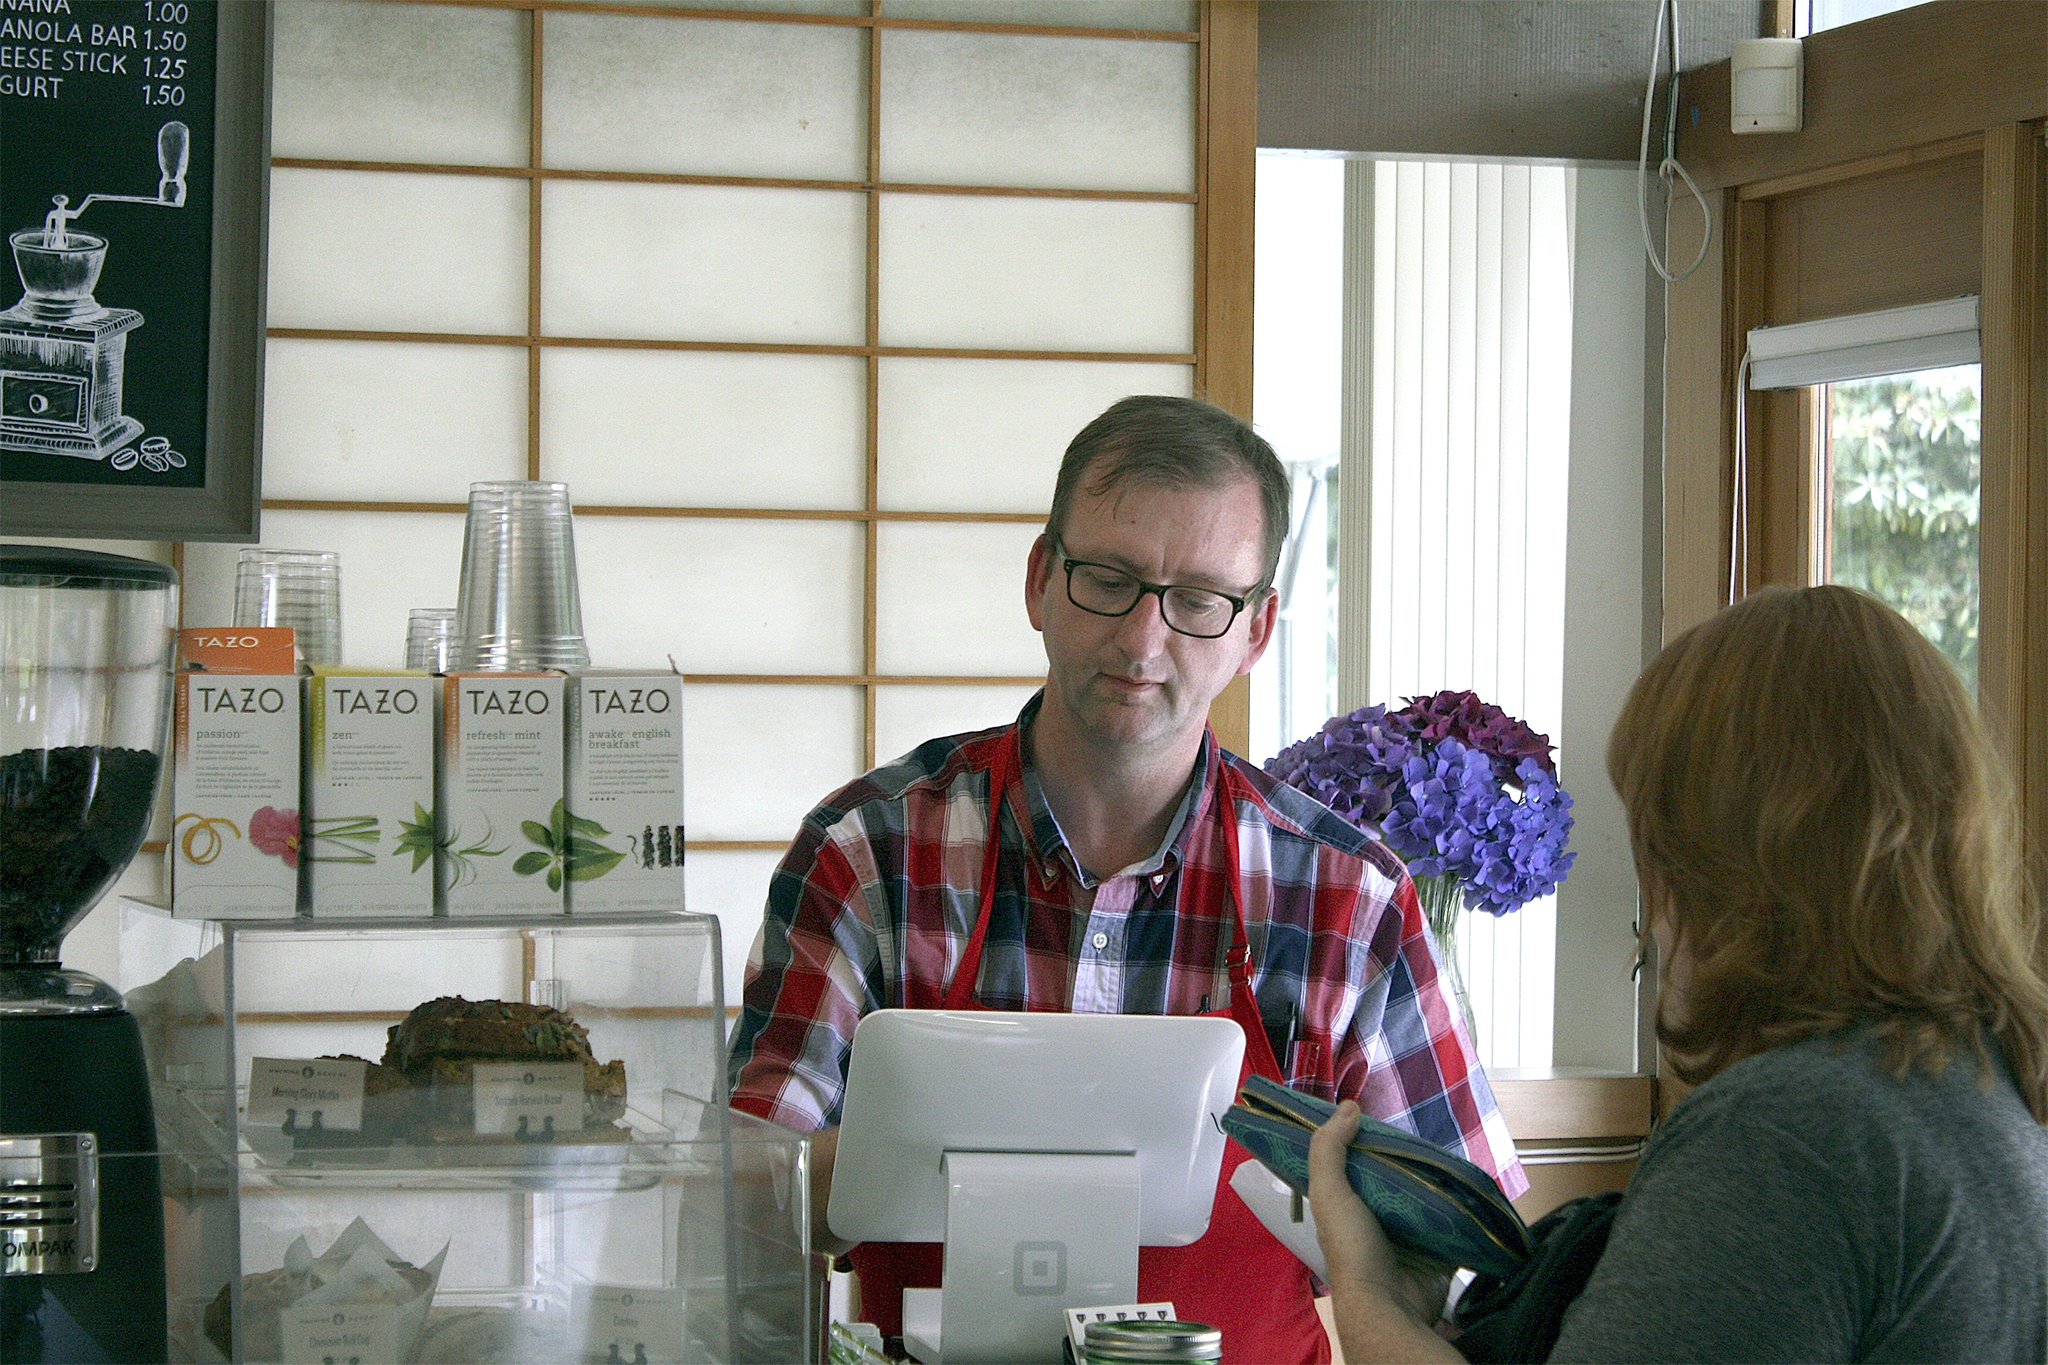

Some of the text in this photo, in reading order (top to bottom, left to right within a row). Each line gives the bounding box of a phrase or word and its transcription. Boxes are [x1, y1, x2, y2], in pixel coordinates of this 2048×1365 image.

[144, 1, 188, 24] 1.00
[1, 18, 187, 51] ANOLA BAR 1.50
[0, 46, 187, 79] EESE STICK 1.25
[0, 74, 185, 106] GURT 1.50
[193, 636, 259, 648] TAZO
[197, 688, 284, 713] TAZO
[332, 689, 418, 714] TAZO
[466, 690, 549, 715] TAZO
[588, 689, 670, 713] TAZO
[196, 729, 241, 741] passion
[332, 731, 352, 740] zen
[466, 729, 541, 740] refresh mint
[588, 729, 671, 741] awake english
[588, 739, 640, 749] breakfast
